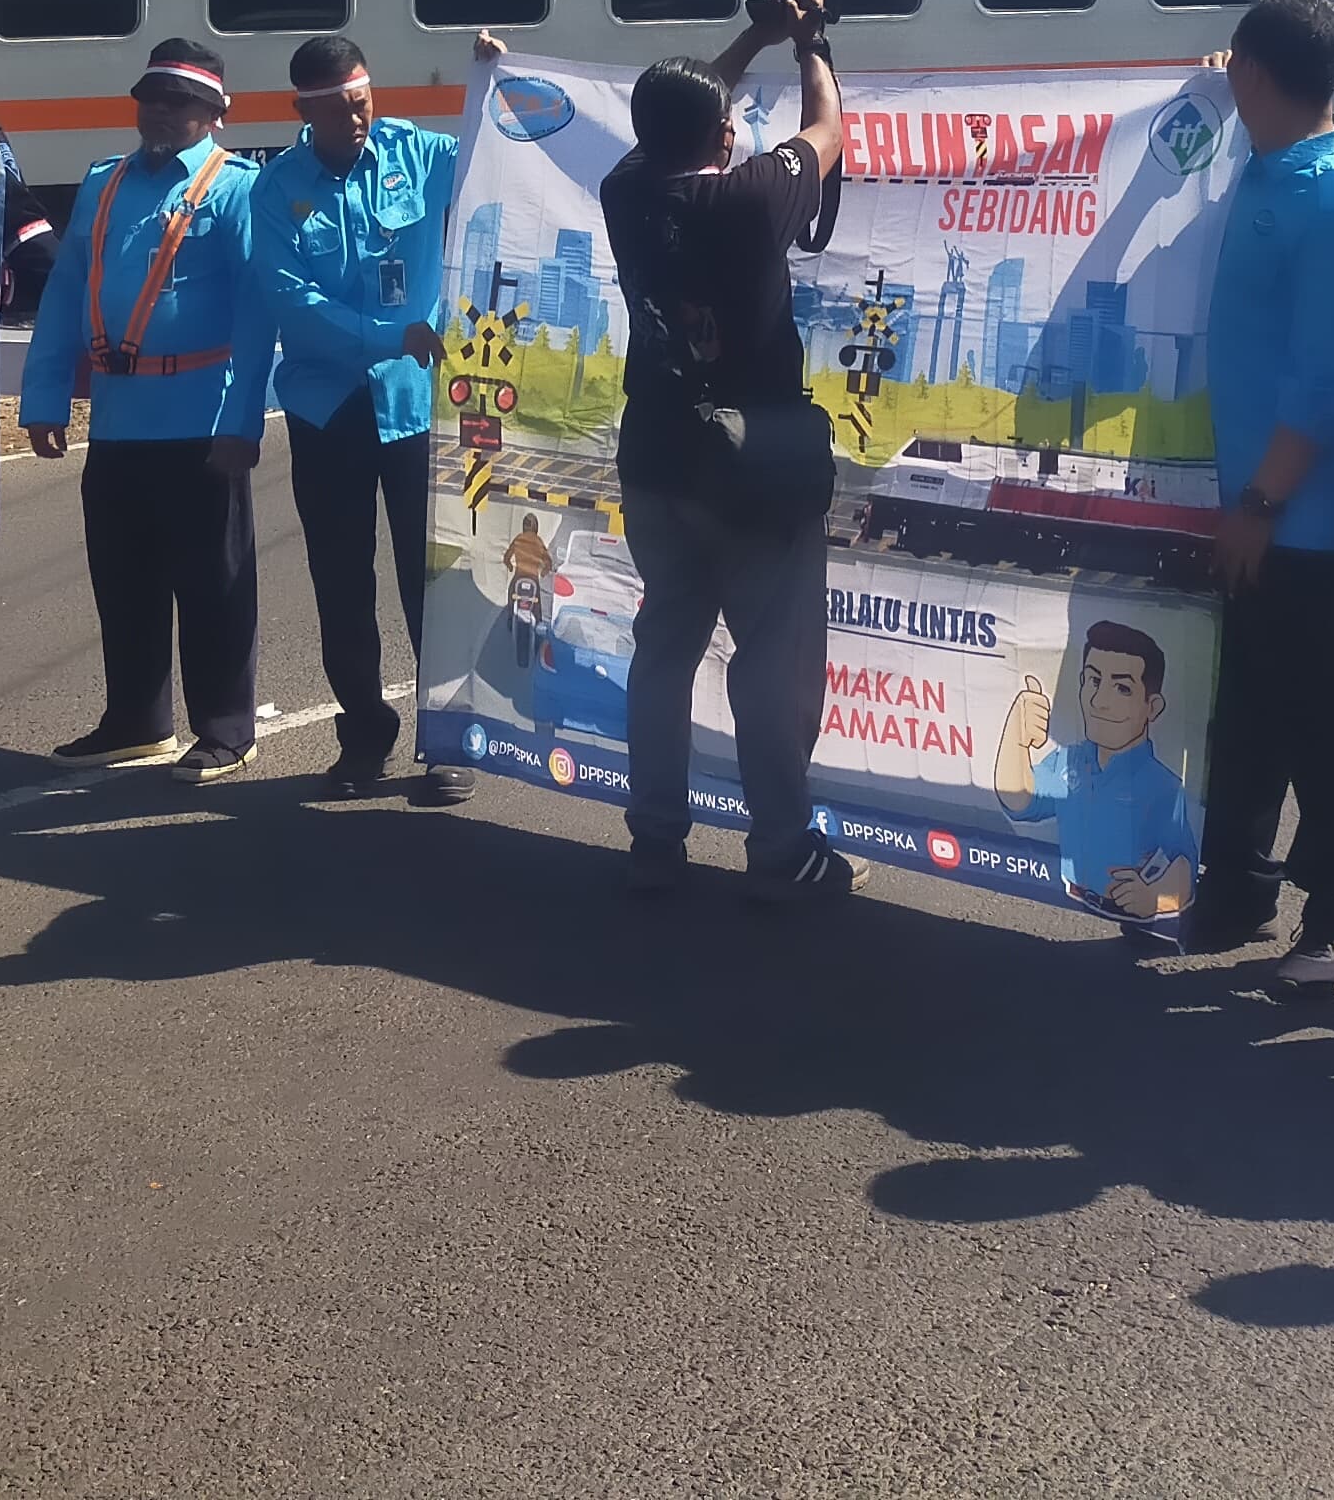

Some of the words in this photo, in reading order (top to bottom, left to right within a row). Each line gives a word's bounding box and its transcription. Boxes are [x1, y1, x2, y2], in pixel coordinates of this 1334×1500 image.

[938, 188, 1097, 236] SEBIDANG
[907, 601, 997, 648] LINTAS
[820, 704, 973, 758] AMATAN
[688, 789, 750, 816] WW.SPK
[843, 820, 917, 852] DPPSPKA
[969, 848, 1001, 869] DPP
[1006, 857, 1051, 882] SPKA
